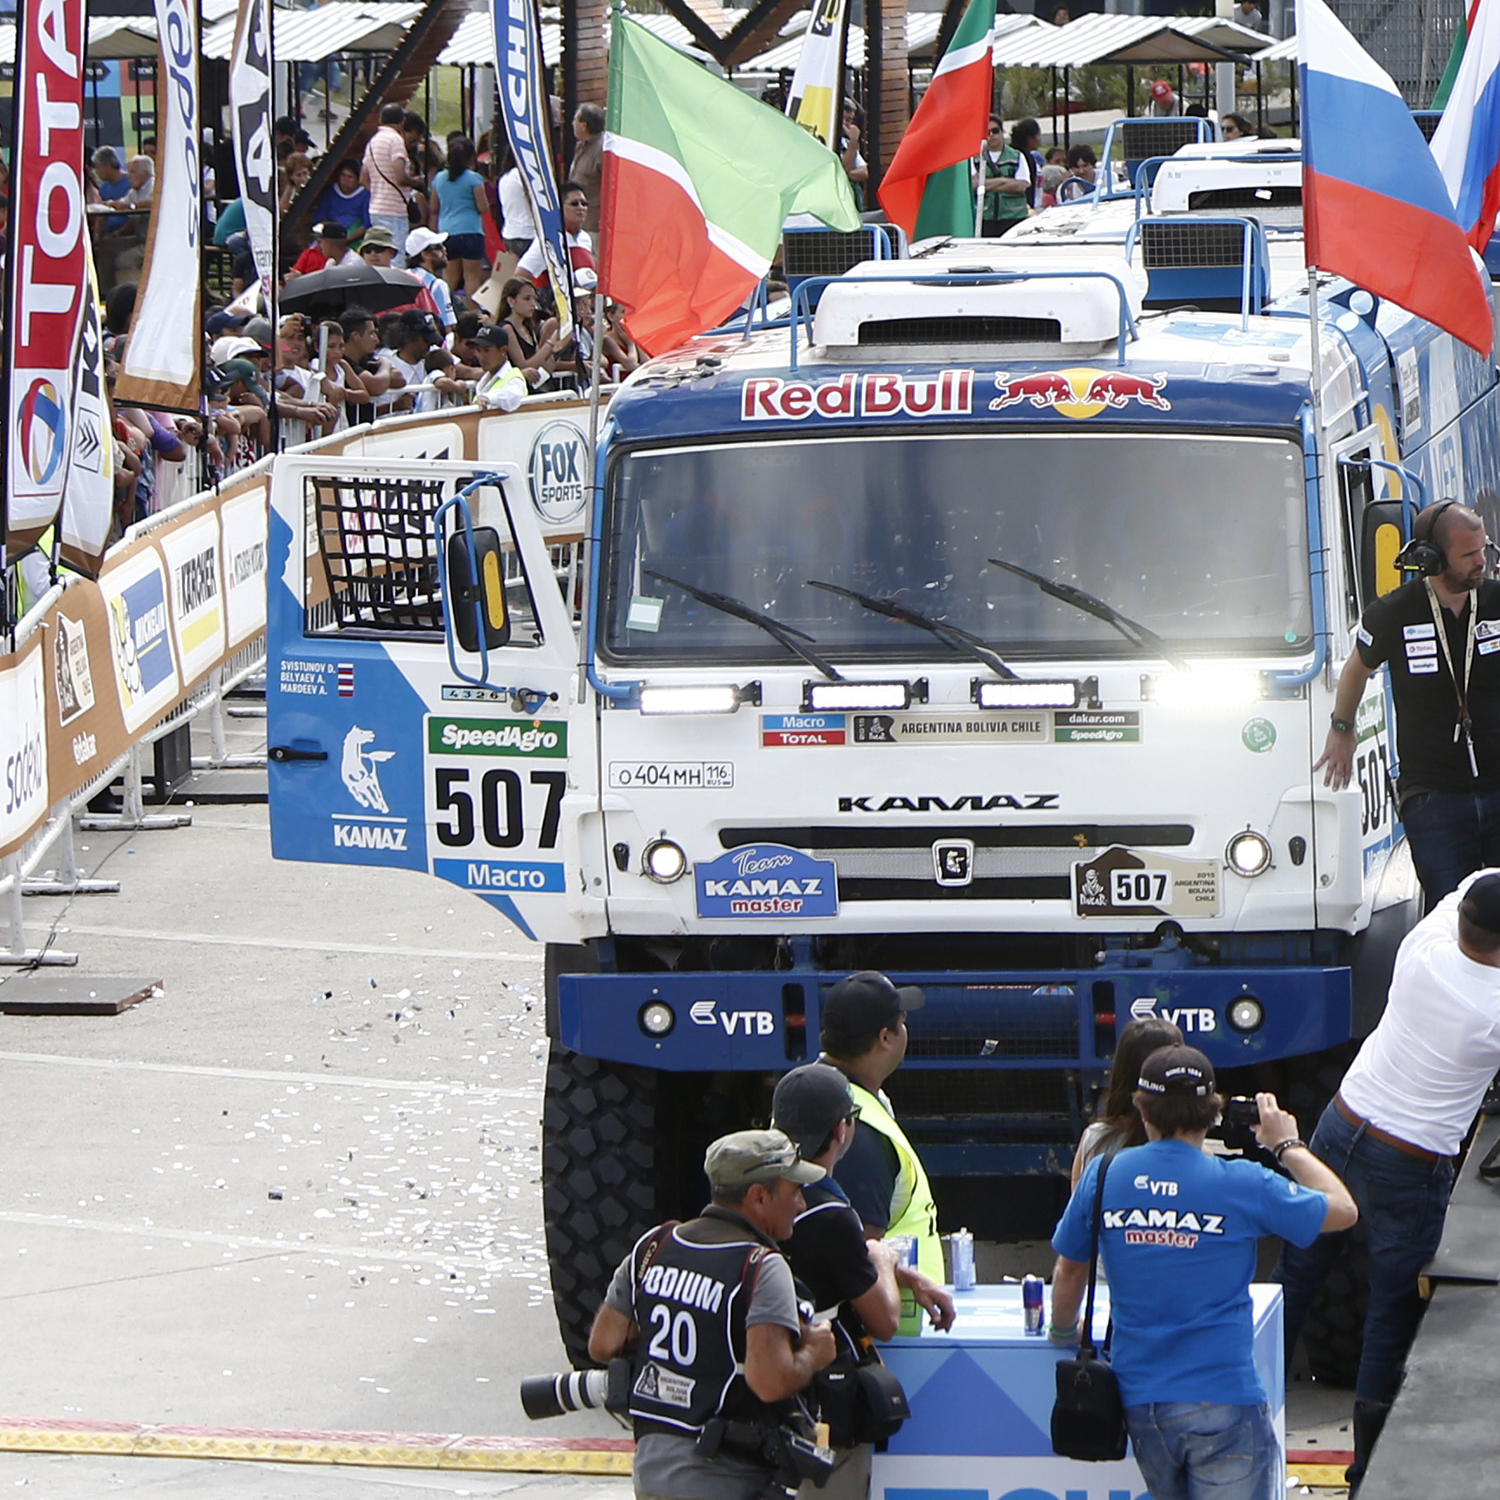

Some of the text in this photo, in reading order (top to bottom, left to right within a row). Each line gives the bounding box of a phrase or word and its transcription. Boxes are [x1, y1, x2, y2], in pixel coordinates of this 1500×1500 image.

[742, 369, 974, 420] Red Bull
[541, 440, 577, 484] FOX
[541, 485, 583, 503] SPORTS
[281, 661, 325, 672] SVISTUNOV
[281, 672, 314, 683] BELYAEV
[280, 683, 317, 695] MARDEEV
[782, 716, 825, 728] Macro
[901, 721, 1041, 733] ARGENTINA BOLIVIA CHILE
[1069, 714, 1125, 723] dakar.com
[441, 724, 558, 751] SpeedAgro
[779, 733, 827, 744] TOTAL
[1070, 730, 1123, 741] SpeedAgro
[706, 766, 727, 779] 116
[435, 768, 566, 848] 507
[837, 794, 1060, 813] KAMAZ
[333, 825, 407, 850] KAMAZ
[732, 849, 793, 876] Team
[467, 864, 545, 888] Macro
[705, 879, 823, 896] KAMAZ
[1117, 874, 1167, 901] 507
[731, 898, 803, 914] master
[719, 1010, 775, 1035] VTB
[1161, 1007, 1217, 1032] VTB
[1150, 1181, 1178, 1196] VTB
[1103, 1209, 1225, 1234] KAMAZ
[1125, 1229, 1199, 1249] master
[649, 1304, 697, 1366] 20
